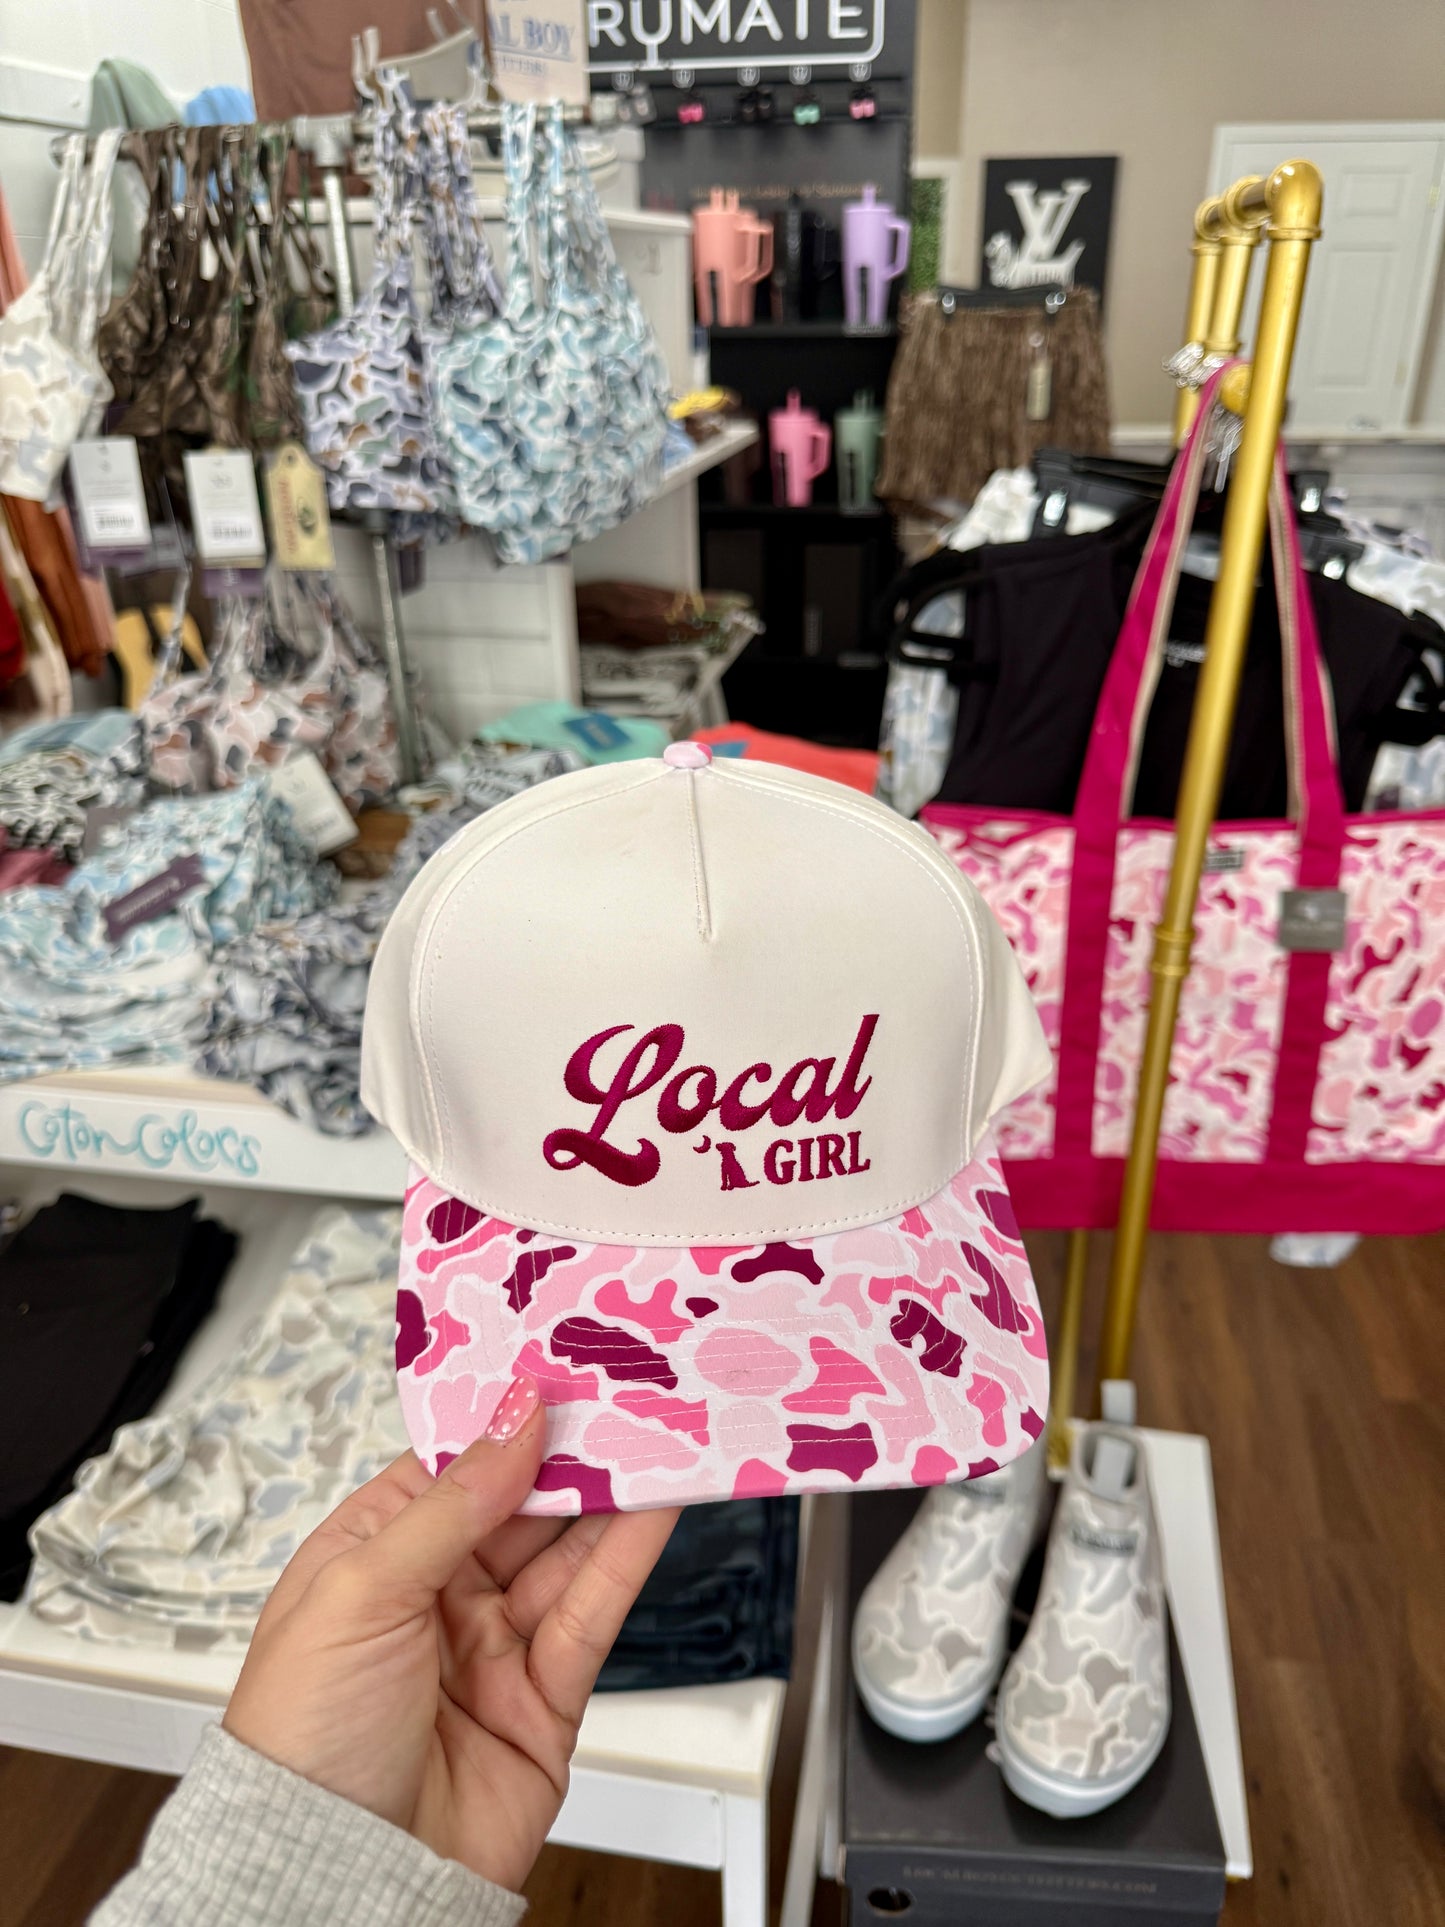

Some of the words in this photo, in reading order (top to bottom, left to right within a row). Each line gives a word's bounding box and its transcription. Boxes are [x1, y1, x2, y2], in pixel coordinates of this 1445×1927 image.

[523, 17, 575, 55] BOY
[542, 1014, 880, 1188] Local
[138, 1109, 261, 1177] Colors
[763, 1131, 871, 1185] GIRL
